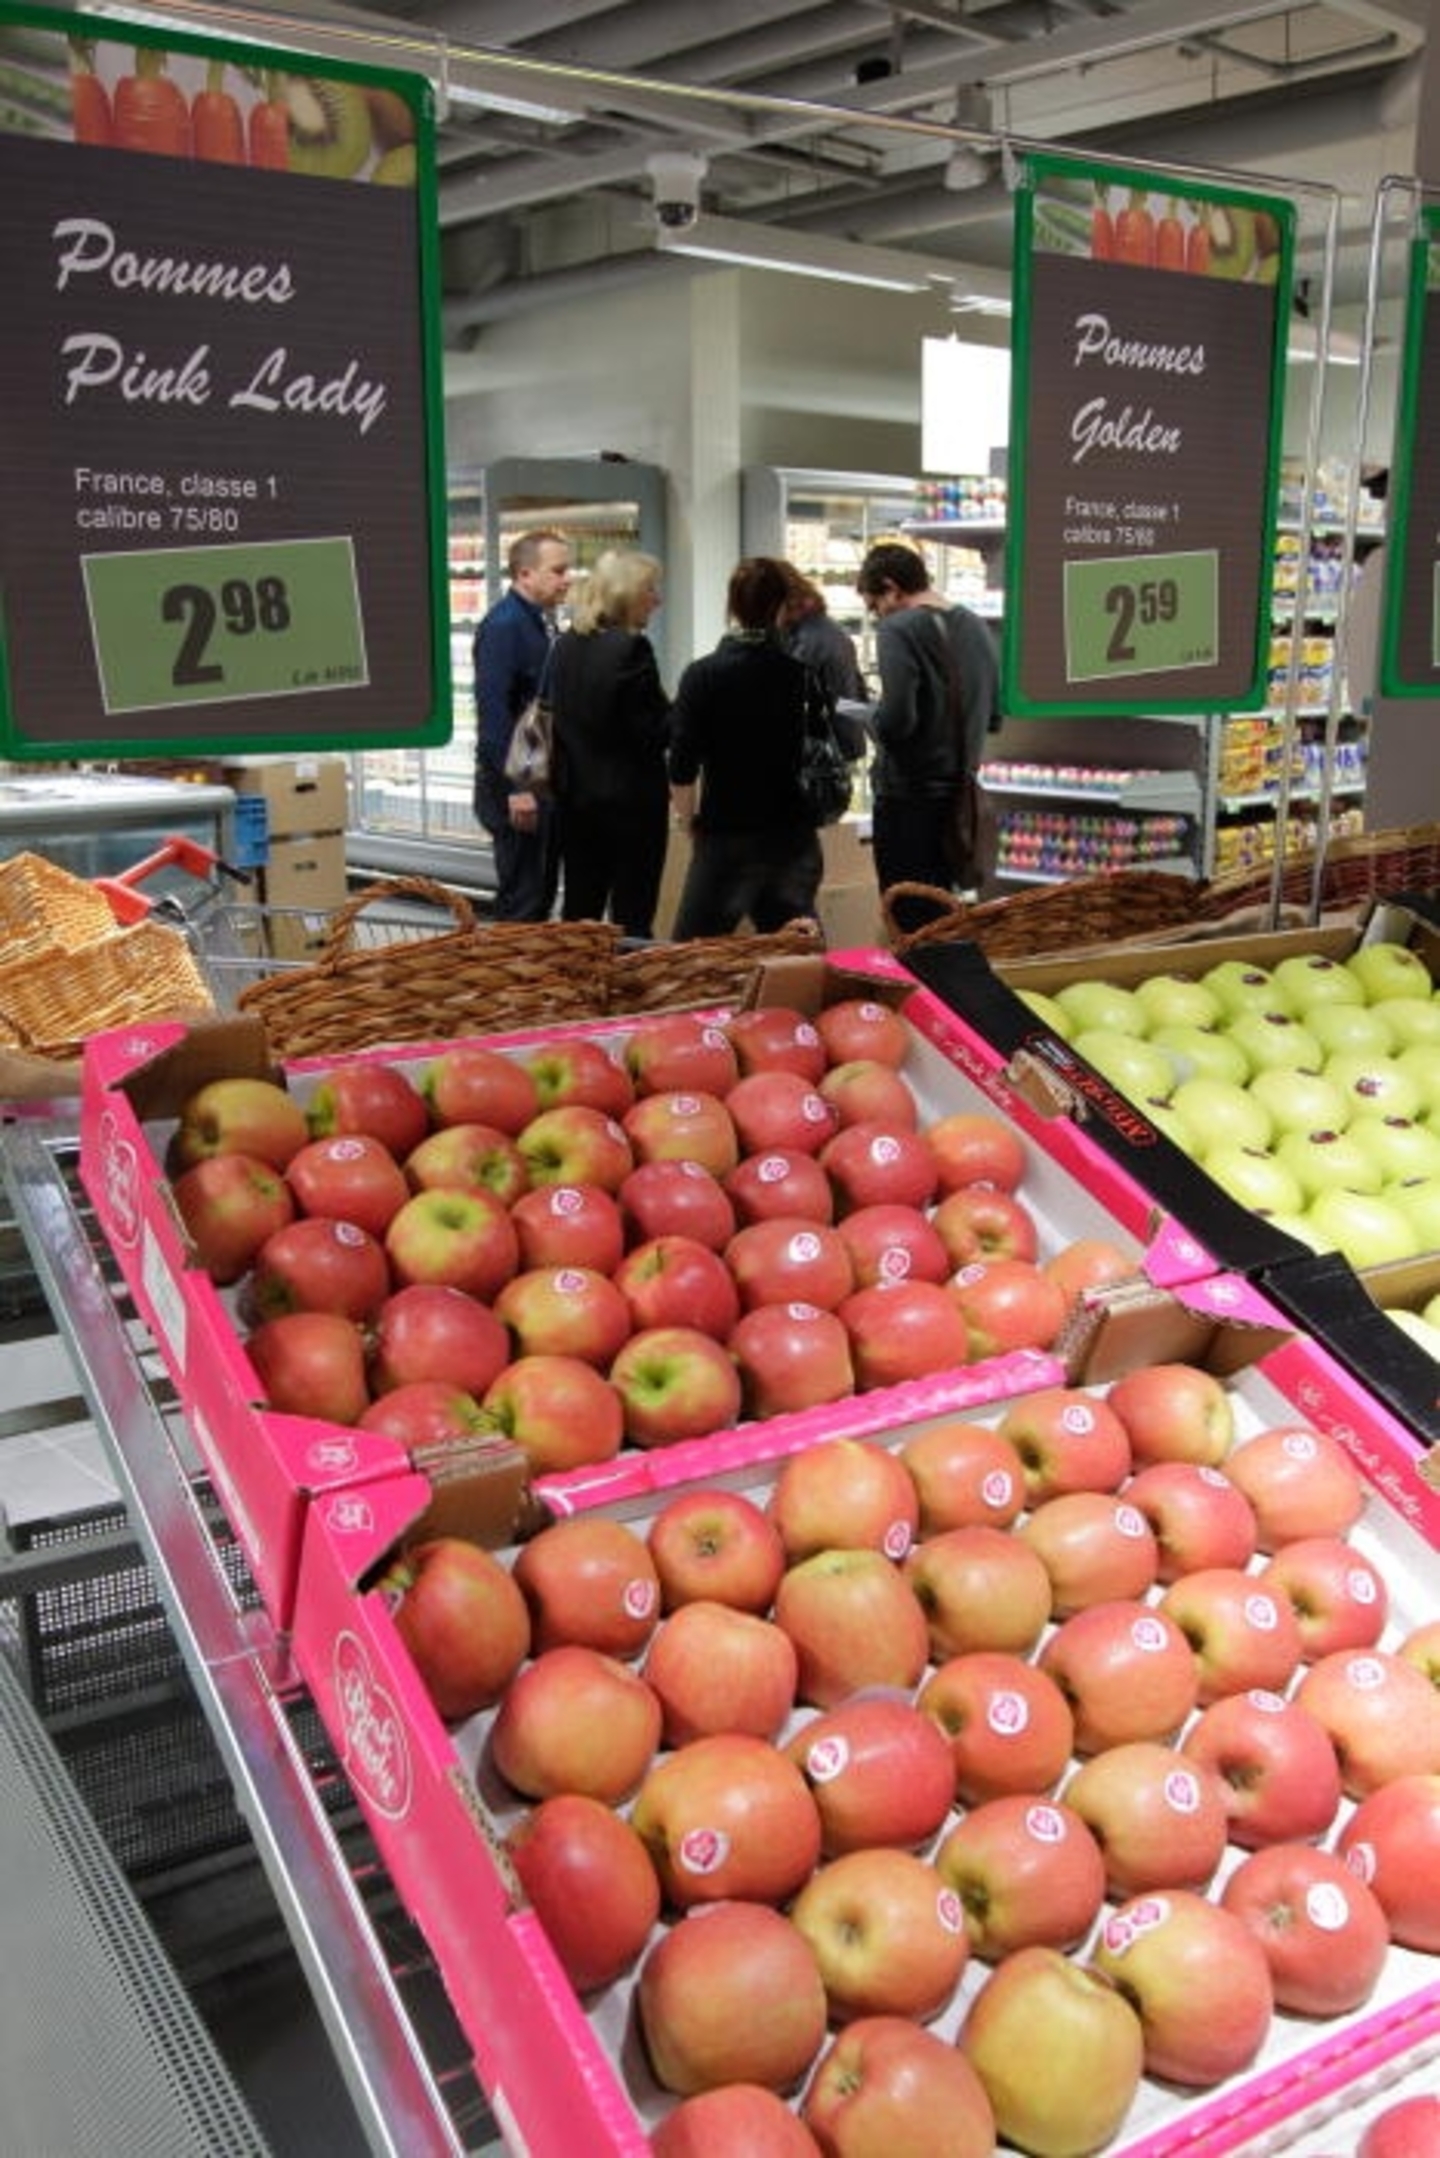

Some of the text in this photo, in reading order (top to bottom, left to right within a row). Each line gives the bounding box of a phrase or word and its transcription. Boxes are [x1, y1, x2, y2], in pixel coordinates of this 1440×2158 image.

[53, 217, 296, 303] Pommes
[1074, 313, 1206, 375] Pommes
[60, 331, 387, 435] Pink Lady
[1071, 397, 1183, 463] Golden
[74, 468, 279, 498] France, classe 1
[75, 503, 240, 532] calibre 75/80
